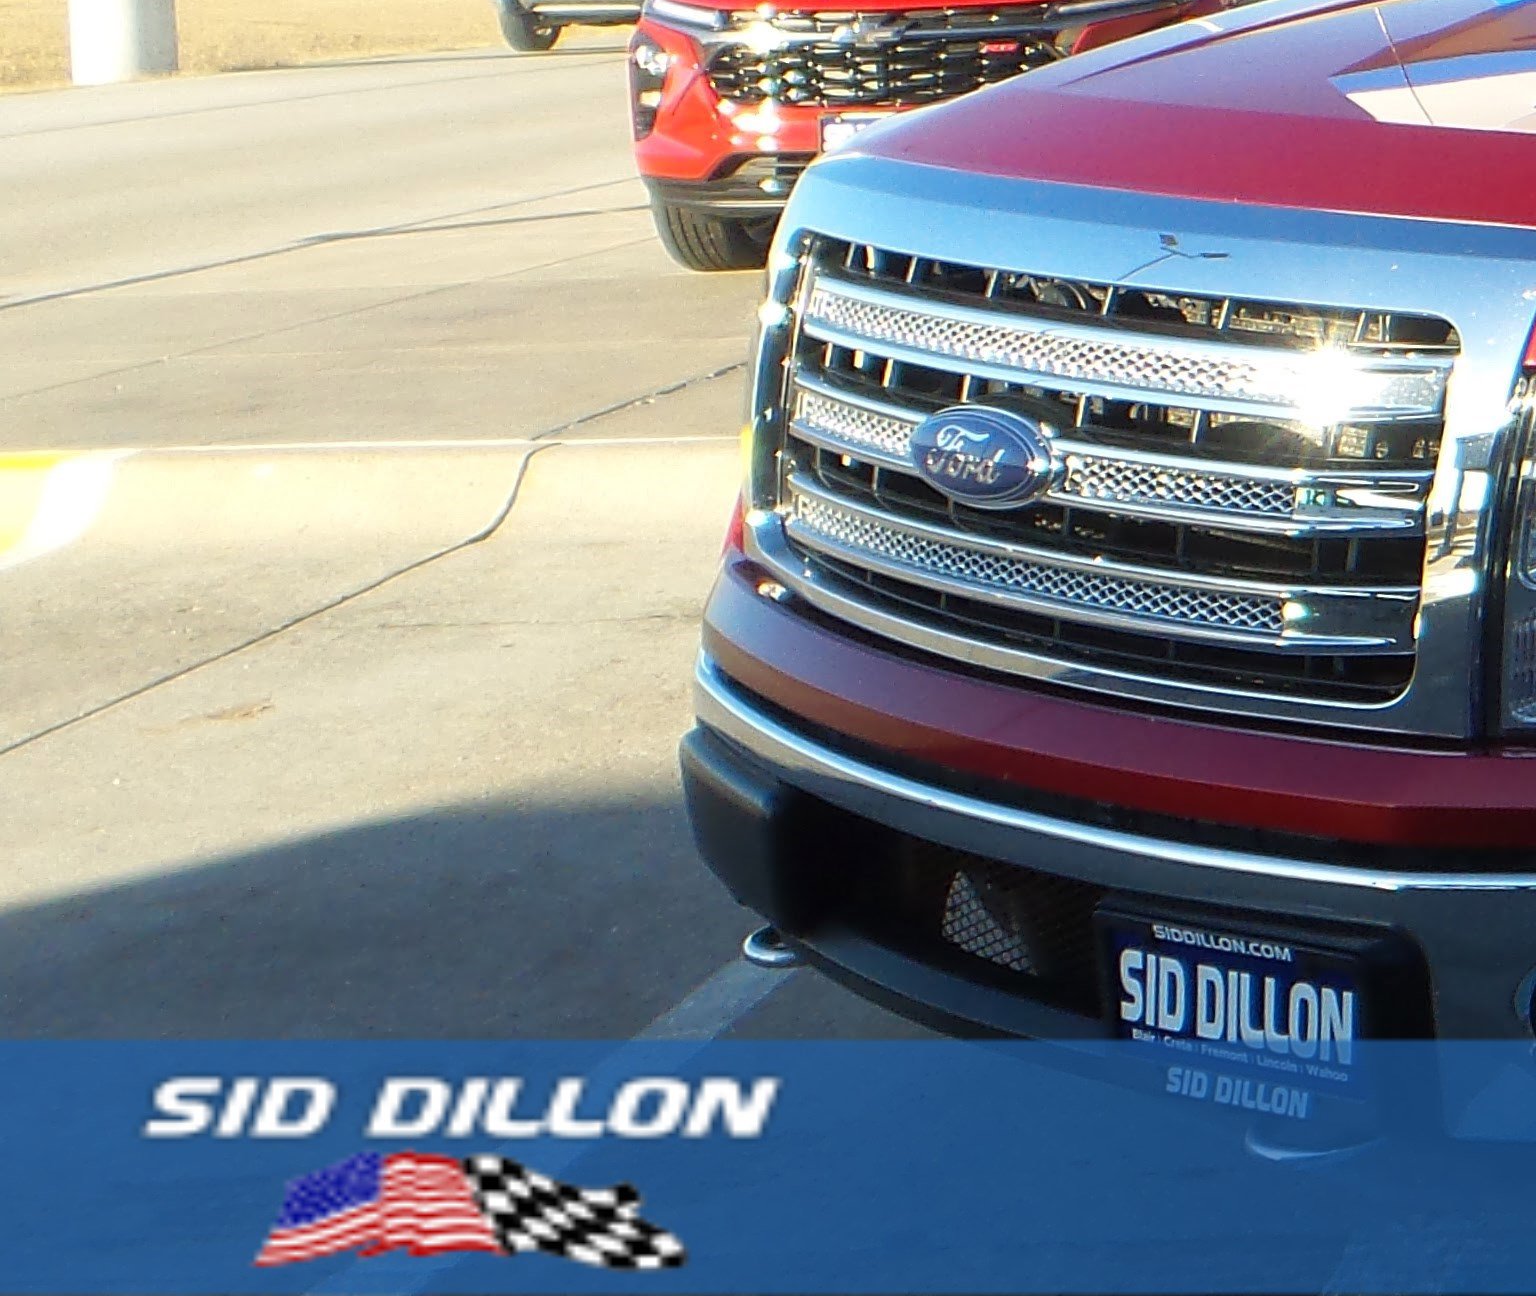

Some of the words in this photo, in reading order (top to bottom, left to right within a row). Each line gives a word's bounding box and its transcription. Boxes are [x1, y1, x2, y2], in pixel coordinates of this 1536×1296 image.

[927, 424, 1005, 485] Ford
[1152, 923, 1293, 962] SIDDILLON.COM
[1119, 947, 1187, 1033] SID
[1196, 964, 1353, 1066] DILLON
[1201, 1043, 1249, 1064] Fremont
[1257, 1054, 1298, 1073] Lincoln
[1306, 1064, 1348, 1082] Wahoo
[1166, 1066, 1209, 1099] SID
[1214, 1075, 1309, 1119] DILLON
